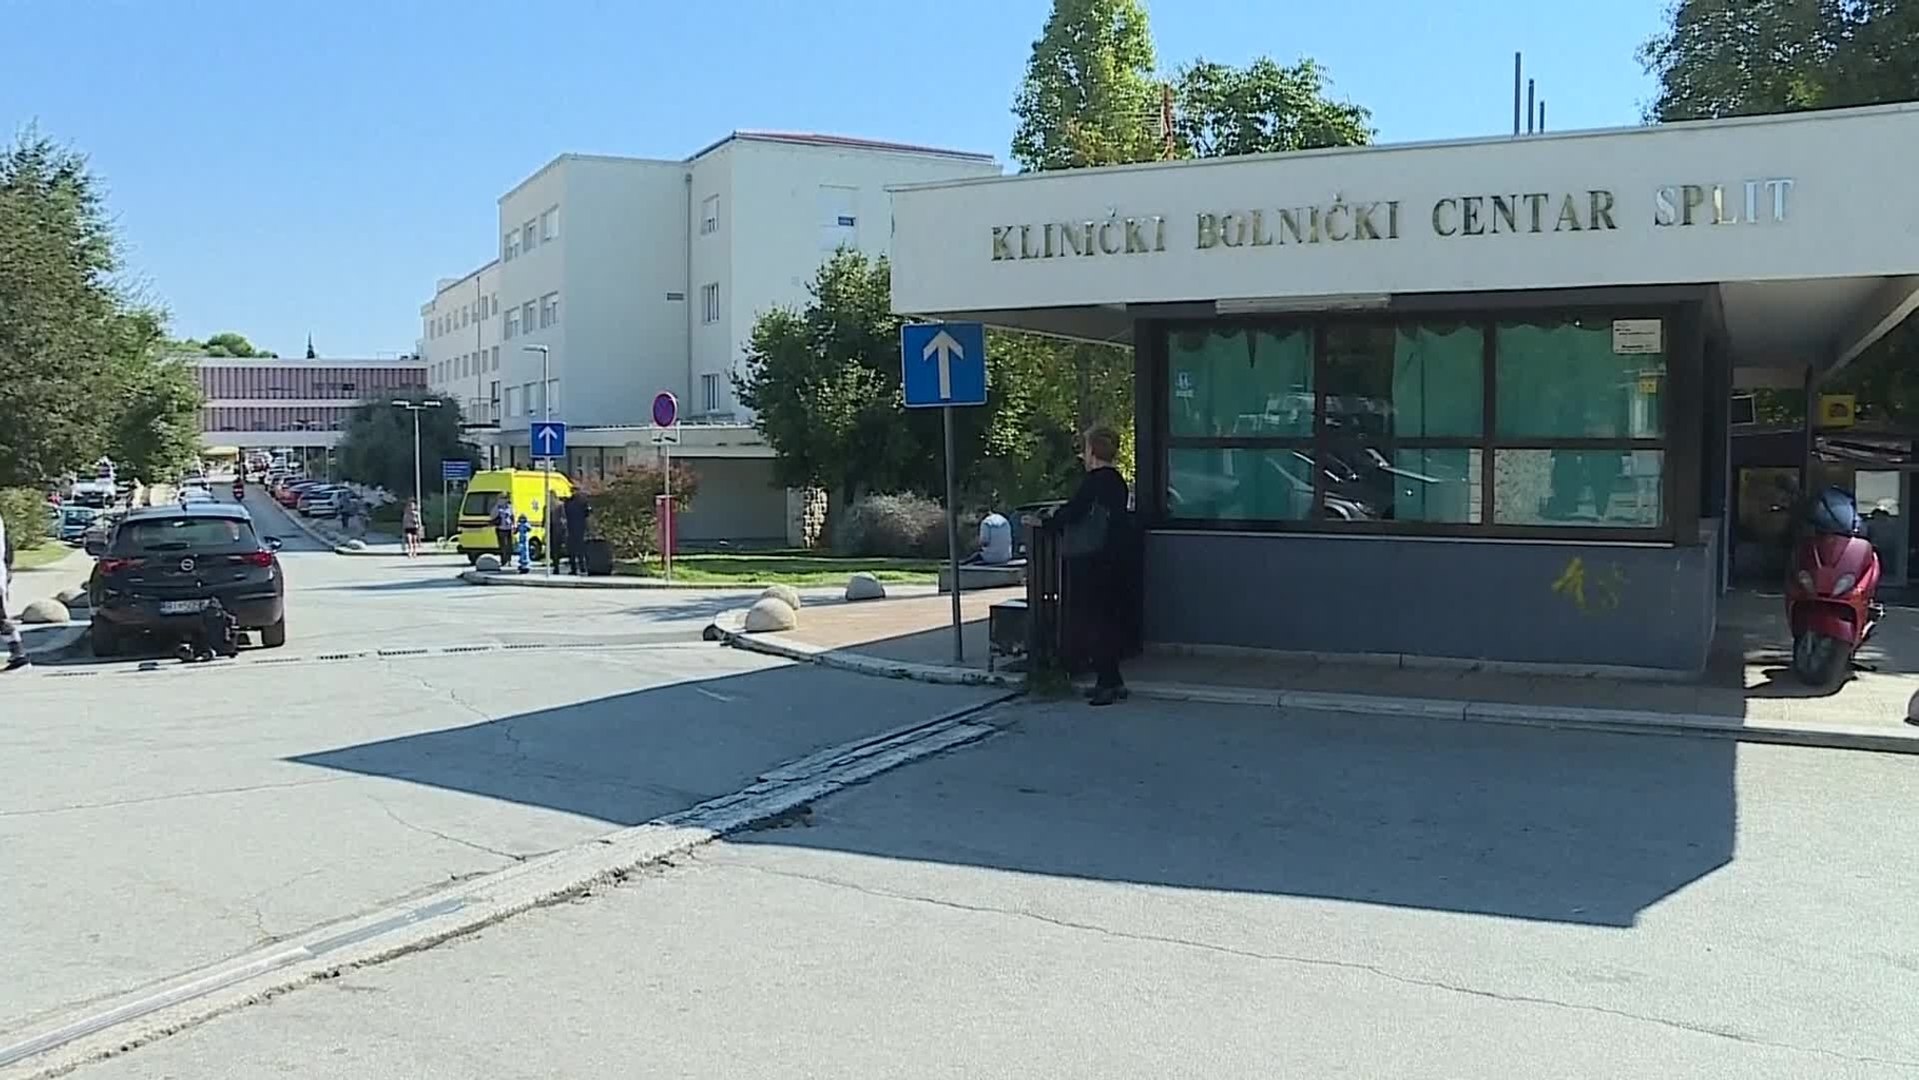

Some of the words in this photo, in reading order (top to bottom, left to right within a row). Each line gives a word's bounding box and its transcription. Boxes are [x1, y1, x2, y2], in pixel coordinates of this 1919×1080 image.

[991, 206, 1167, 261] KLINIČKI
[1195, 191, 1400, 250] BOLNIČKI
[1431, 188, 1618, 237] CENTAR
[1654, 177, 1793, 226] SPLIT
